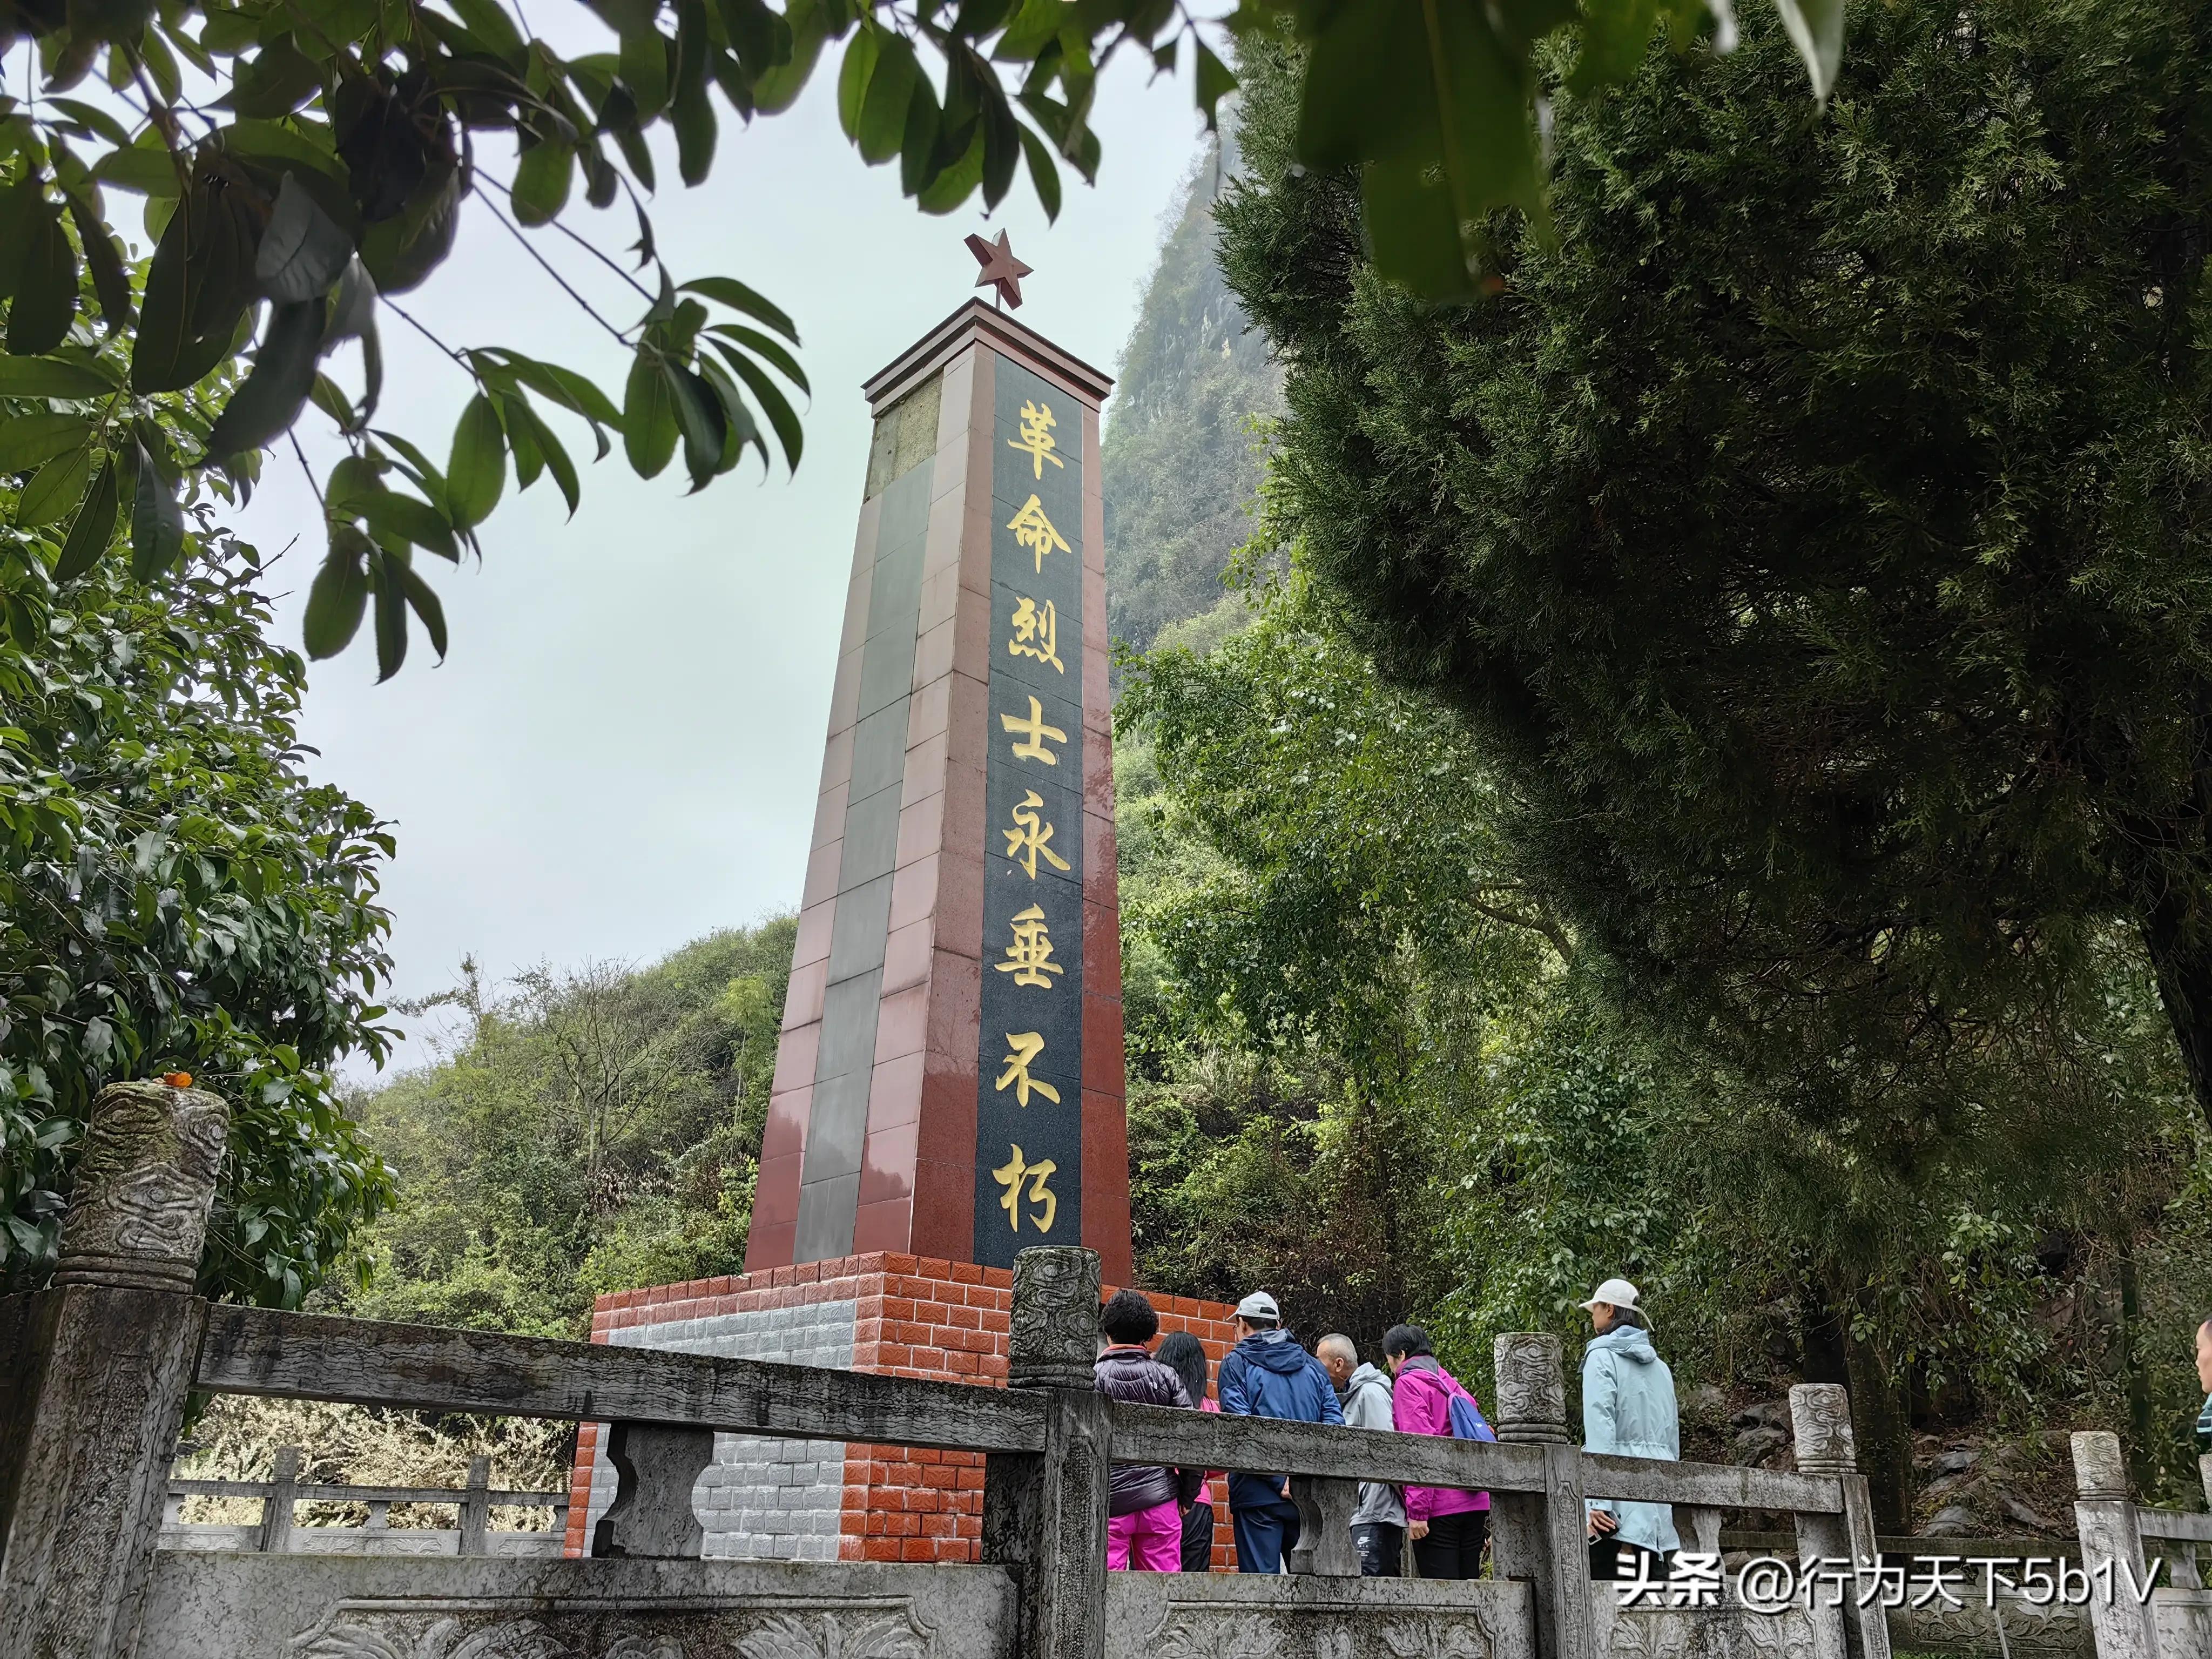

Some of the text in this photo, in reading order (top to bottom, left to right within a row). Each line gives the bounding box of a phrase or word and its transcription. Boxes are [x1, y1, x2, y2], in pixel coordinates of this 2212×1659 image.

[992, 399, 1071, 1233] 革命烈士永垂不朽
